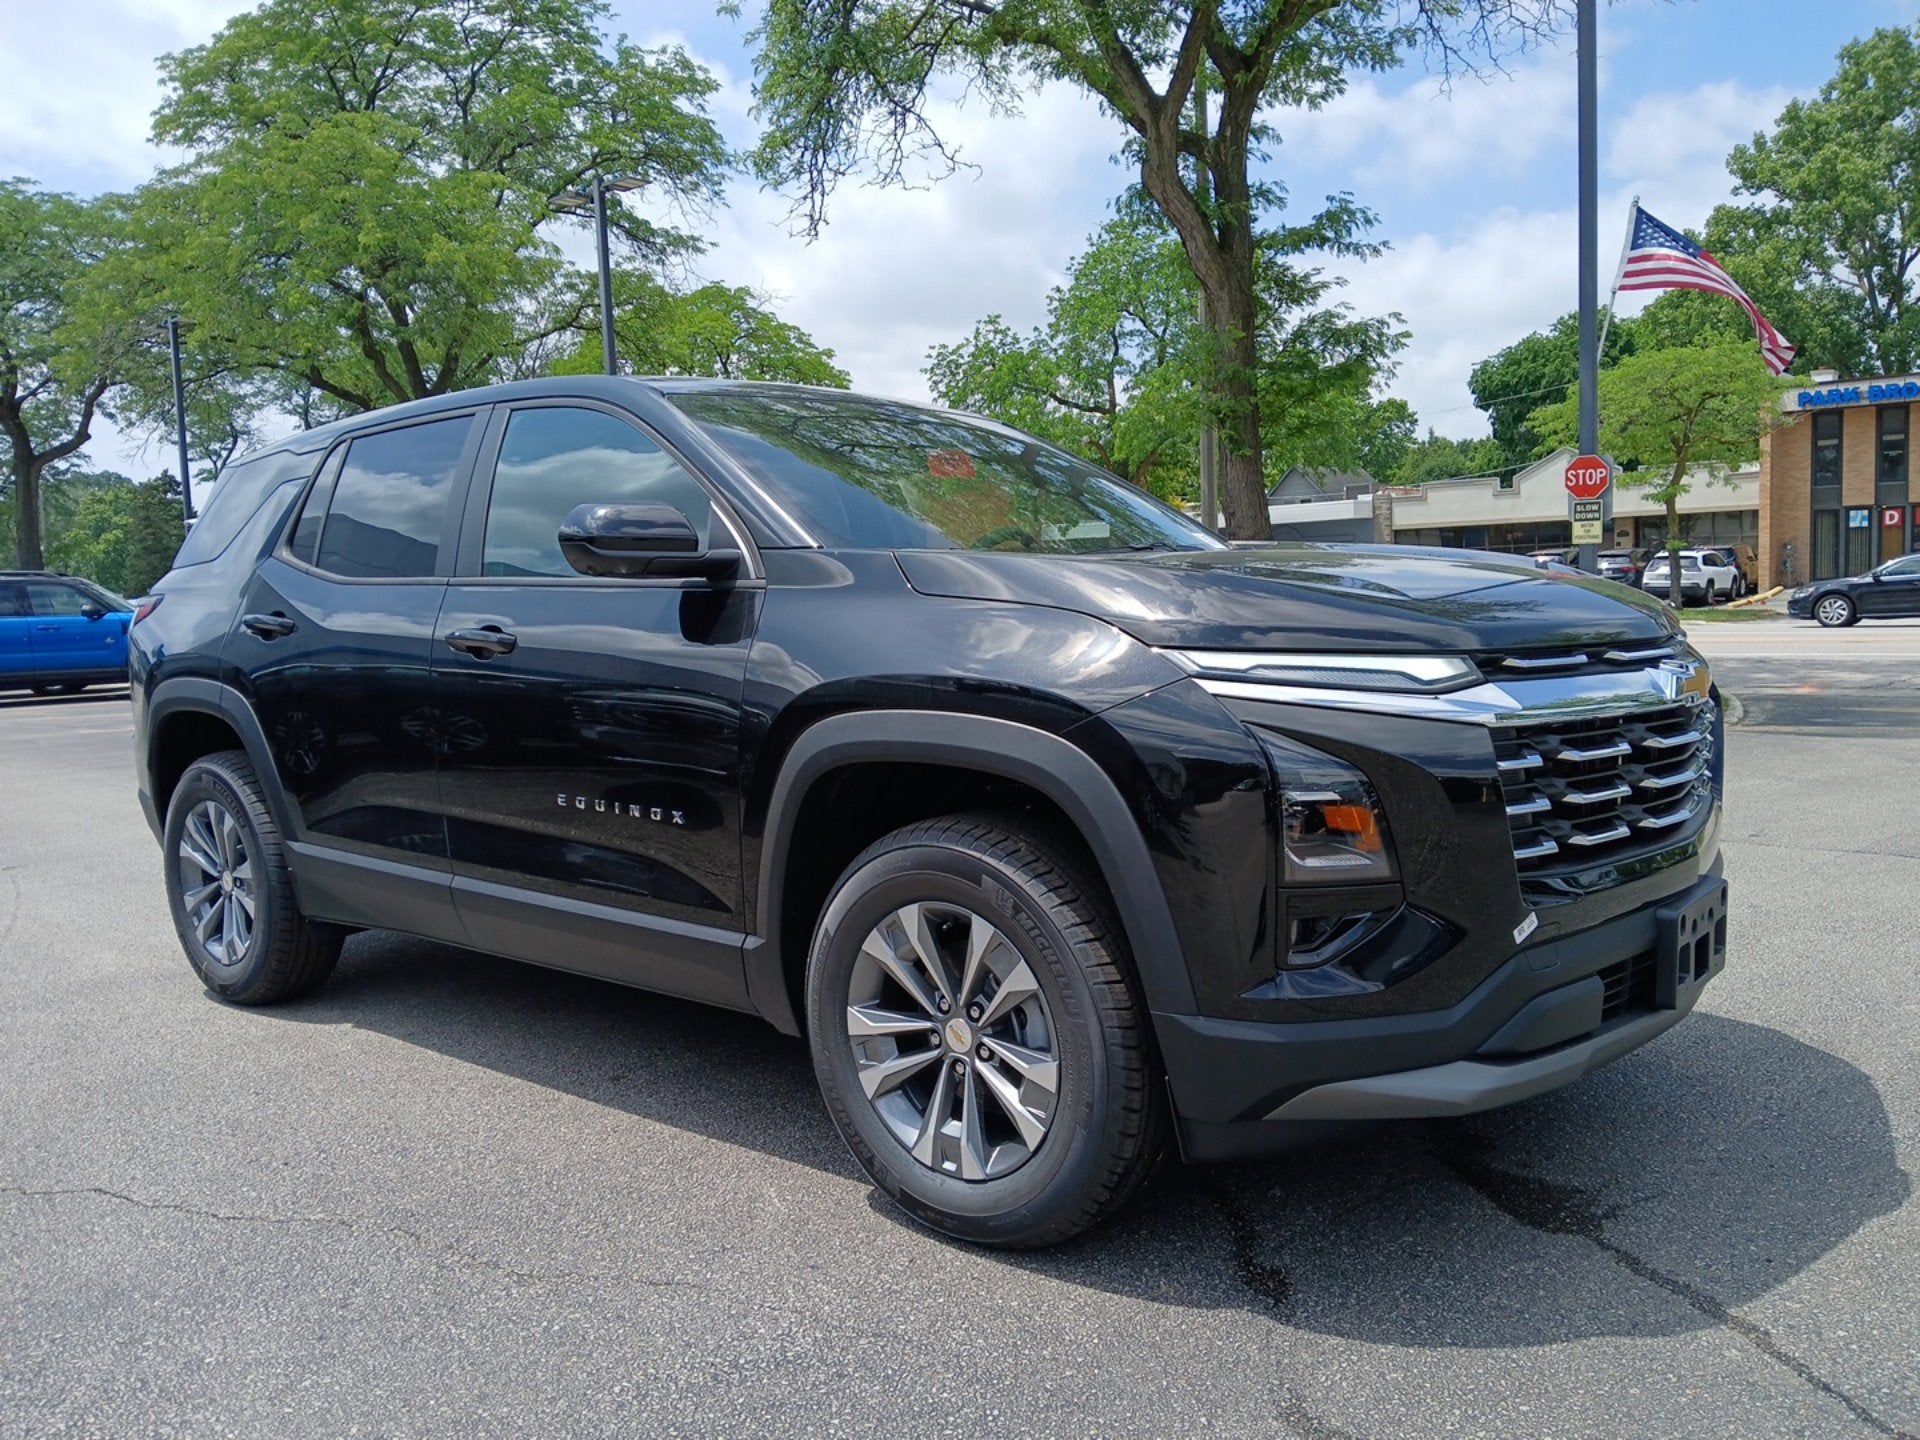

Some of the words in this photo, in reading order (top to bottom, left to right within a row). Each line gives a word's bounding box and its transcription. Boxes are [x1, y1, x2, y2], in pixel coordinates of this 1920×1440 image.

[1798, 387, 1860, 408] PARK
[1567, 468, 1606, 486] STOP
[1575, 504, 1600, 512] SLOW
[1575, 512, 1600, 520] DOWN
[1885, 510, 1900, 525] D
[557, 794, 684, 825] EQUINOX
[1014, 911, 1081, 1018] MICHELIN
